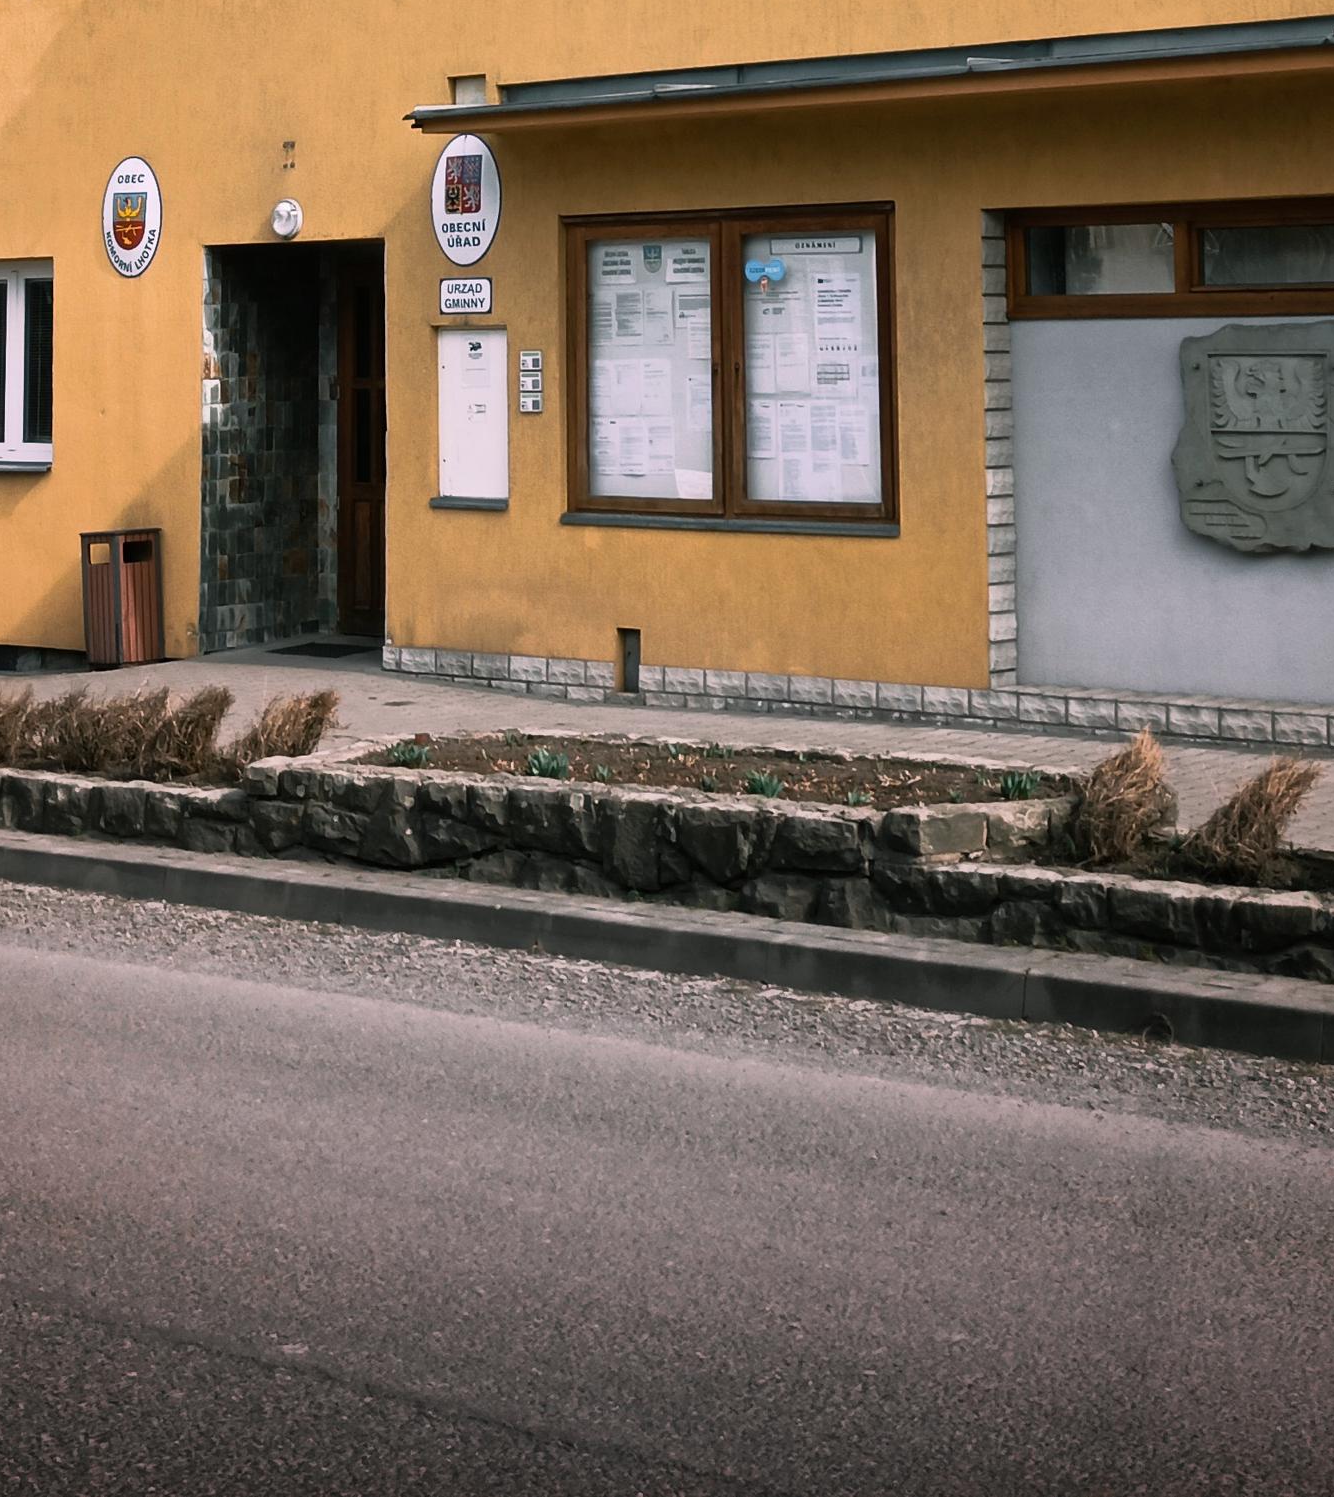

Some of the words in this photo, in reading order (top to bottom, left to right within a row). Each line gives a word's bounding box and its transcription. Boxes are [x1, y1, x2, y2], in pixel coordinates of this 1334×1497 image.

[117, 174, 145, 184] OBEC
[441, 218, 486, 234] OBECNÍ
[447, 234, 481, 248] ÚŘAD
[106, 231, 133, 272] KOMORNÍ
[134, 229, 157, 270] LHOTKA
[447, 283, 483, 297] URZĄD
[444, 298, 486, 309] GMINNY
